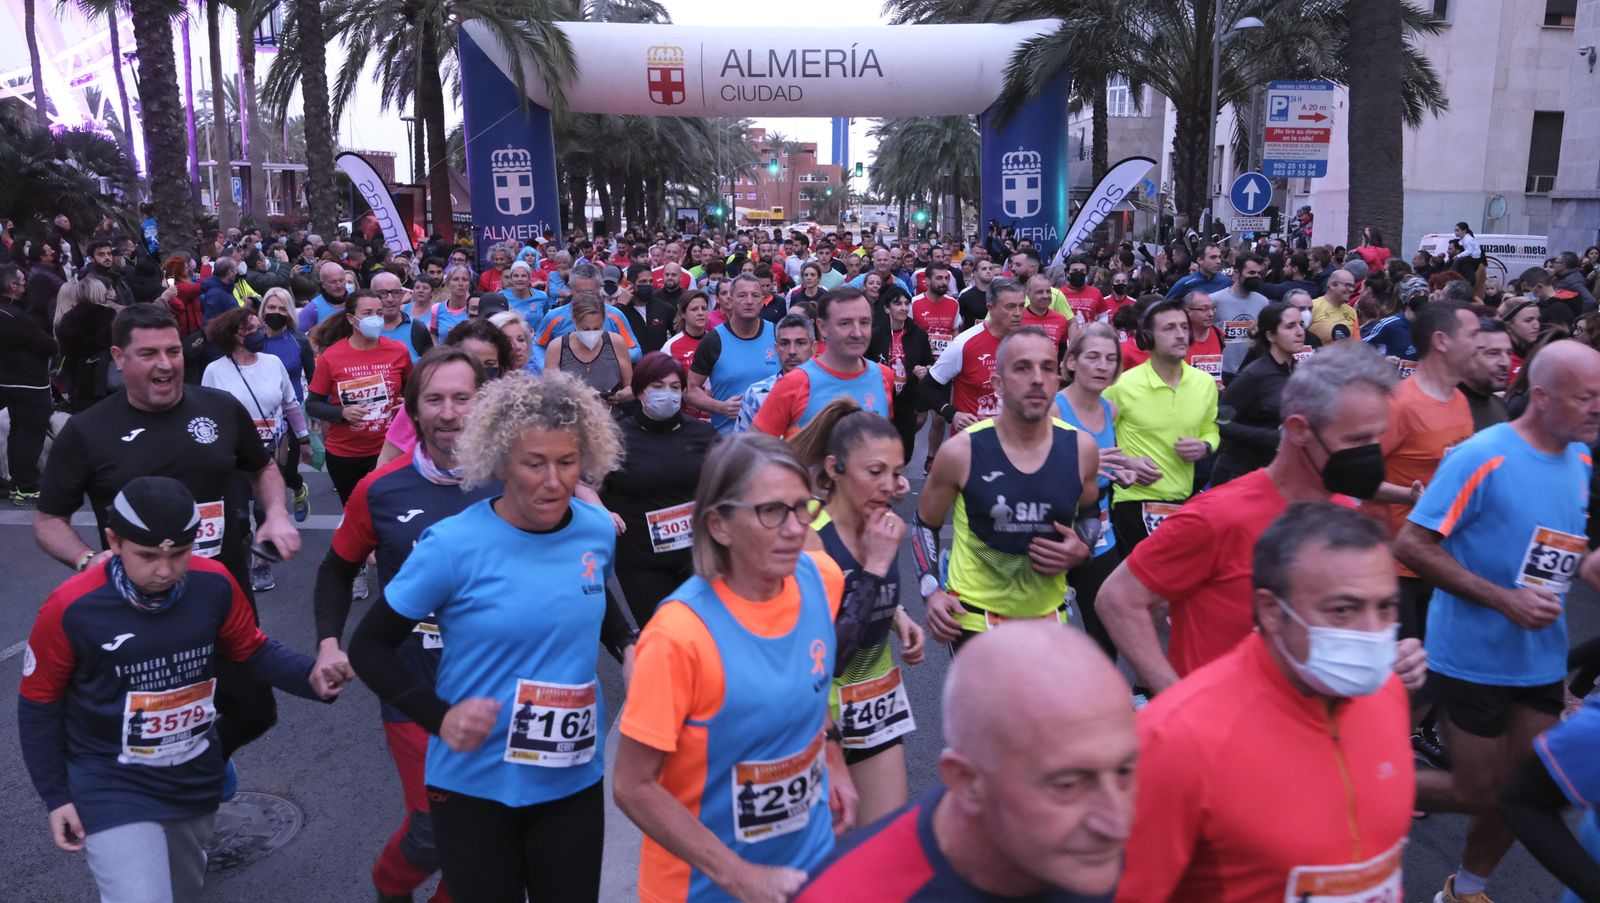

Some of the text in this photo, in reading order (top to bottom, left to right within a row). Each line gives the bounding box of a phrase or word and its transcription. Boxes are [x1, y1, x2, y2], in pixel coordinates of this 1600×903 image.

[720, 43, 884, 78] ALMERÍA
[720, 84, 803, 102] CIUDAD
[350, 387, 379, 400] 3477
[1015, 502, 1052, 521] SAF
[124, 656, 167, 674] CARRERA
[146, 705, 204, 734] 3579
[857, 691, 896, 724] 467
[538, 709, 591, 739] 162
